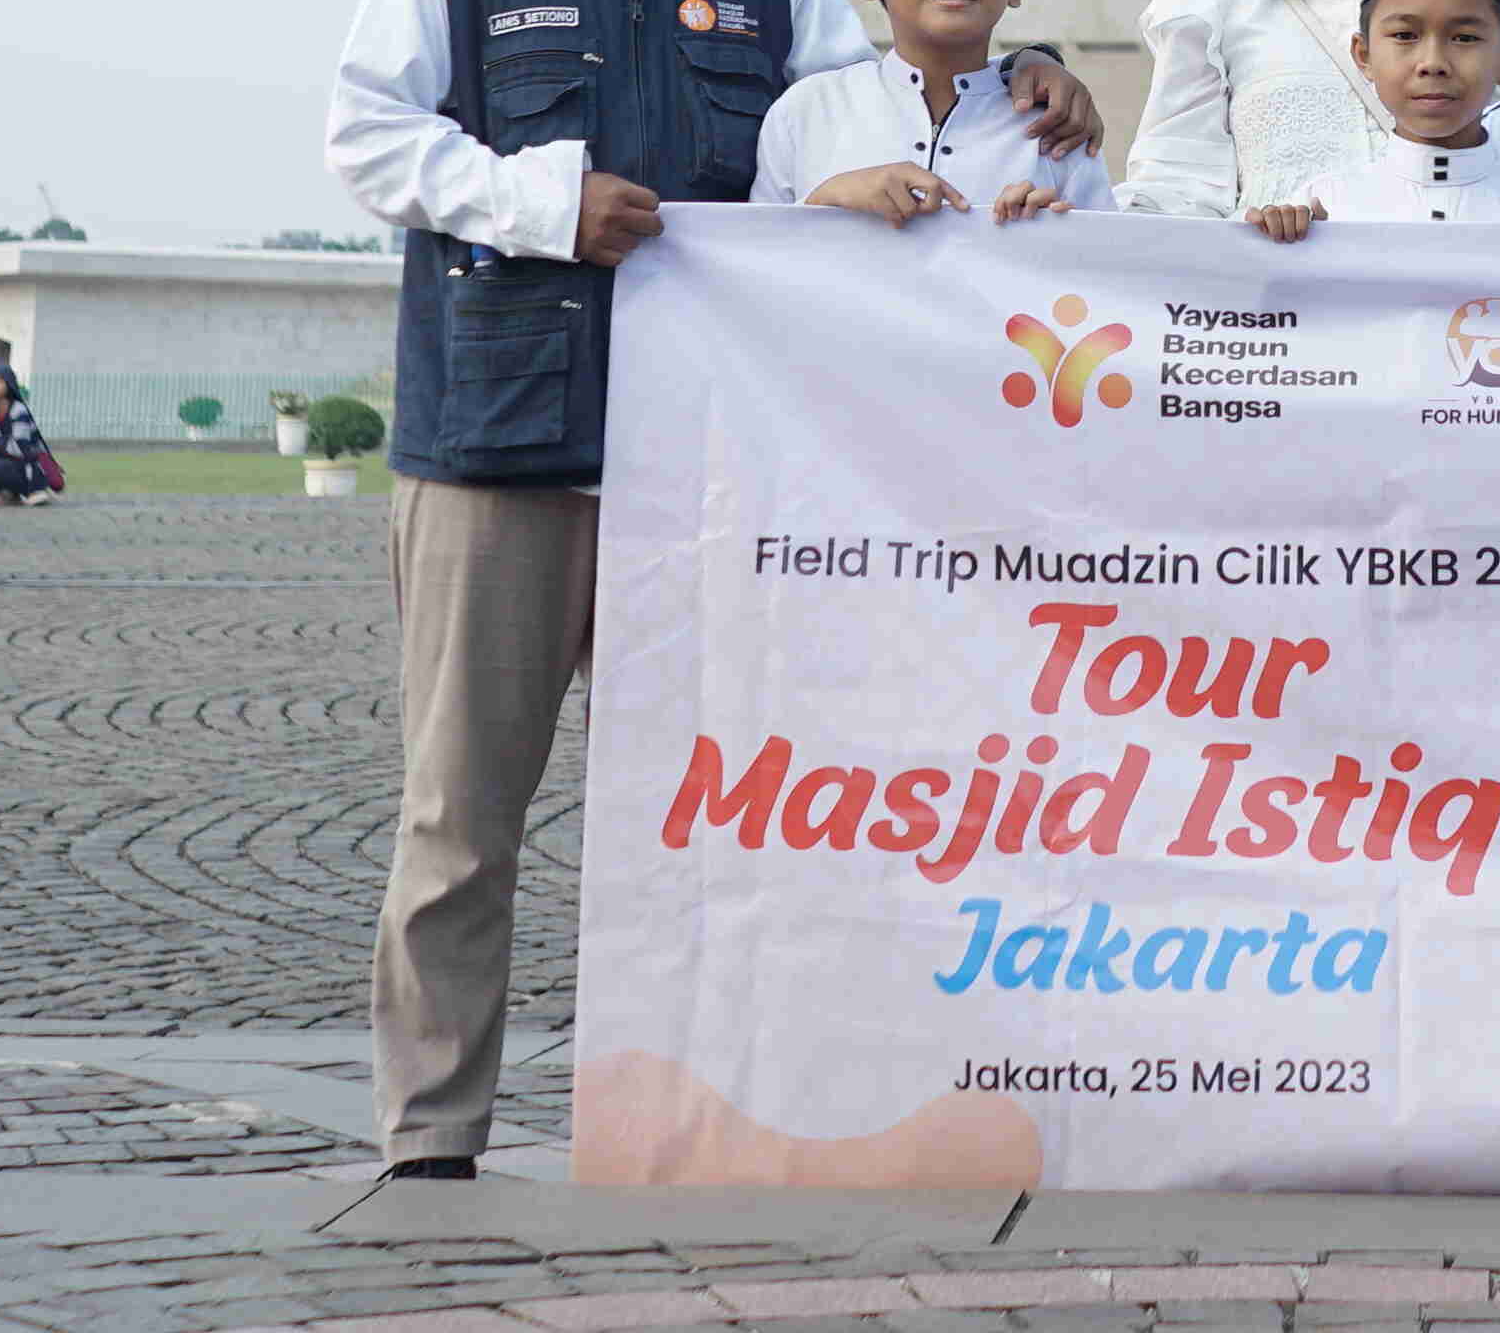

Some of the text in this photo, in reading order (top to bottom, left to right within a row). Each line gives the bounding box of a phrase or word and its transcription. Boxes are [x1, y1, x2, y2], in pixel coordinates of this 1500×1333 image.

[524, 11, 575, 24] SETIONO
[1164, 302, 1297, 331] Yayasan
[1163, 334, 1288, 361] Bangun
[1160, 362, 1358, 386] Kecerdasan
[1160, 394, 1281, 423] Bangsa
[1421, 409, 1461, 425] FOR
[754, 536, 871, 580] Field
[887, 540, 979, 594] Trip
[995, 544, 1199, 586] Muadzin
[1216, 544, 1321, 587] Cilik
[1336, 548, 1460, 588] YBKB
[1028, 603, 1331, 721] Tour
[661, 734, 1151, 885] Masjid
[933, 899, 1389, 995] Jakarta
[954, 1058, 1372, 1101] Jakarta, 25 Mei 2023
